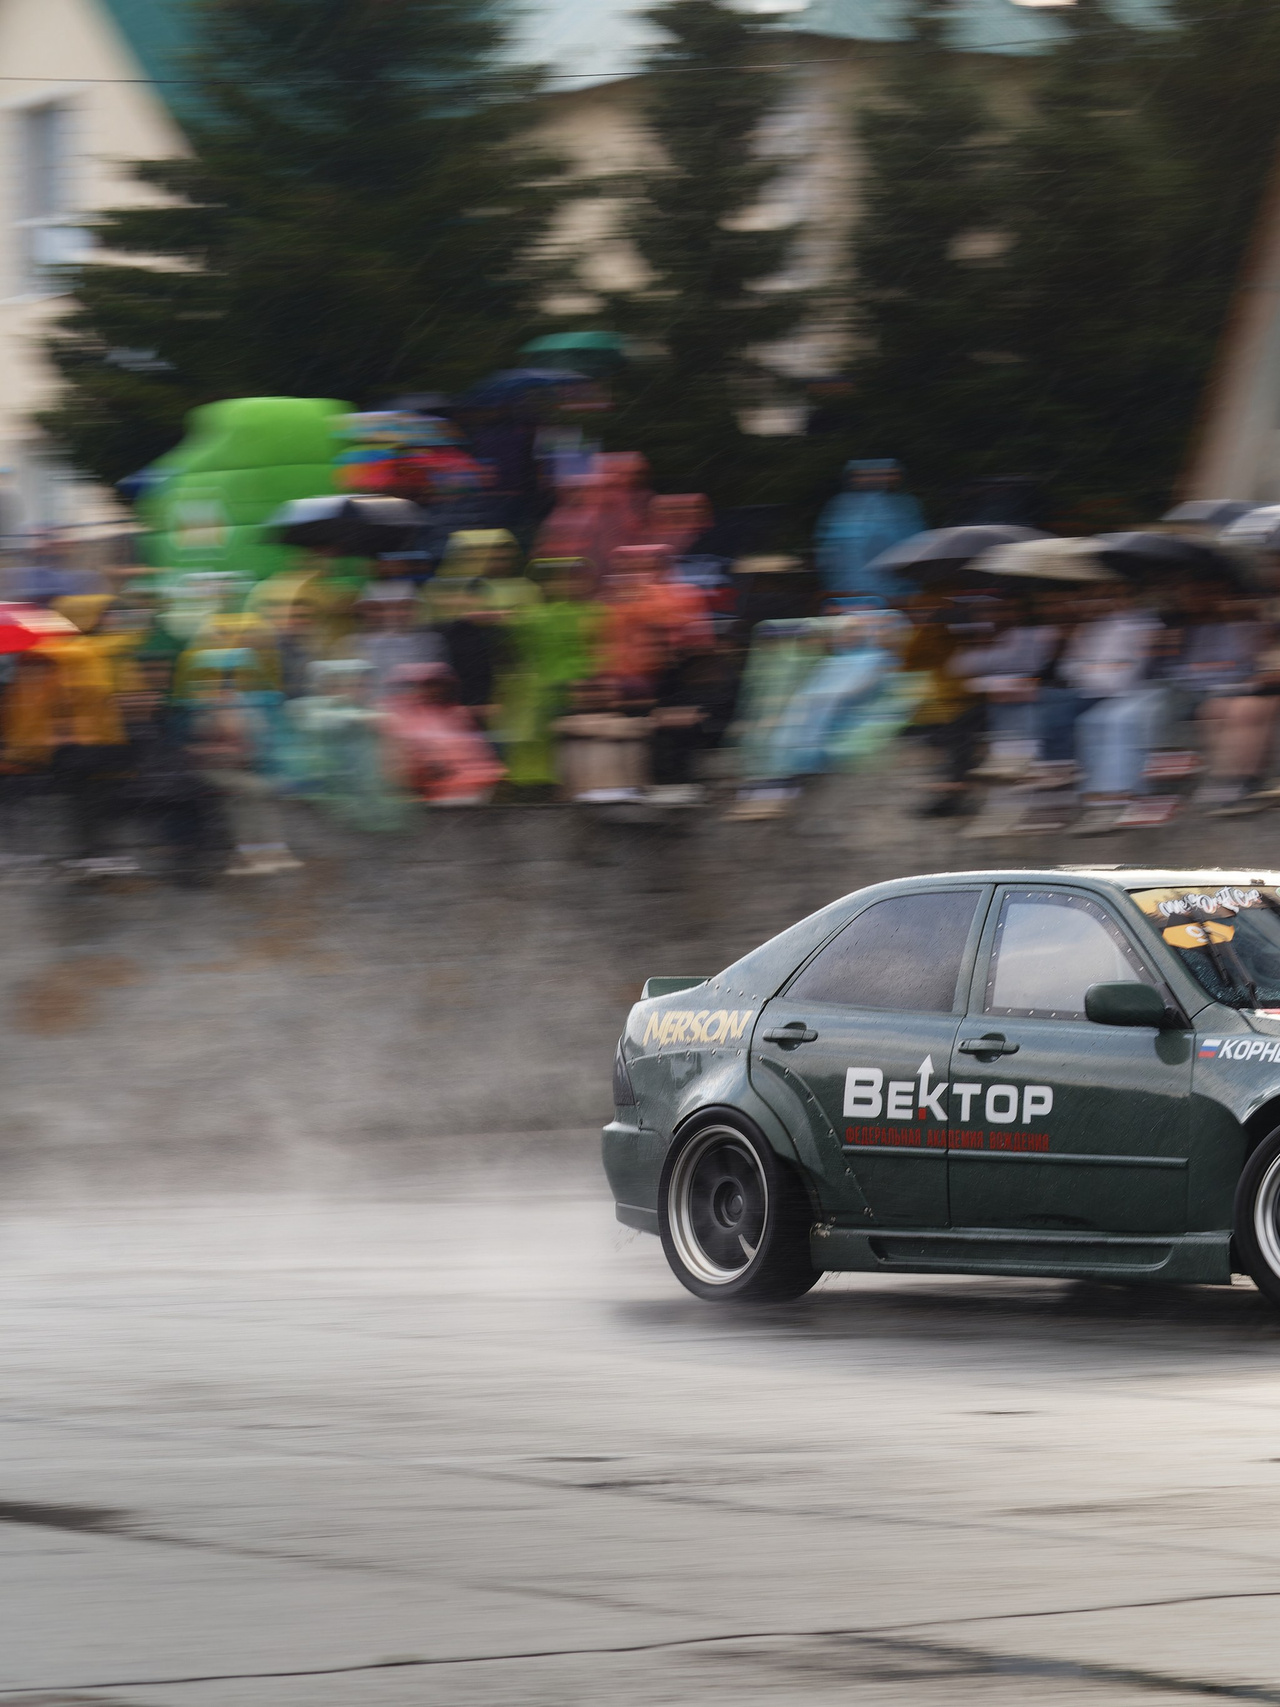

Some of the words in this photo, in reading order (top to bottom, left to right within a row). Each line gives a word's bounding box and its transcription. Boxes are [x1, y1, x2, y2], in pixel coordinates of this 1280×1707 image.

[643, 1009, 754, 1047] NERSON
[845, 1126, 921, 1145] ФЕДЕРАЛЬНАЯ
[926, 1129, 984, 1149] АКАДЕМИЯ
[989, 1132, 1050, 1152] ВОЖДЕНИЯ
